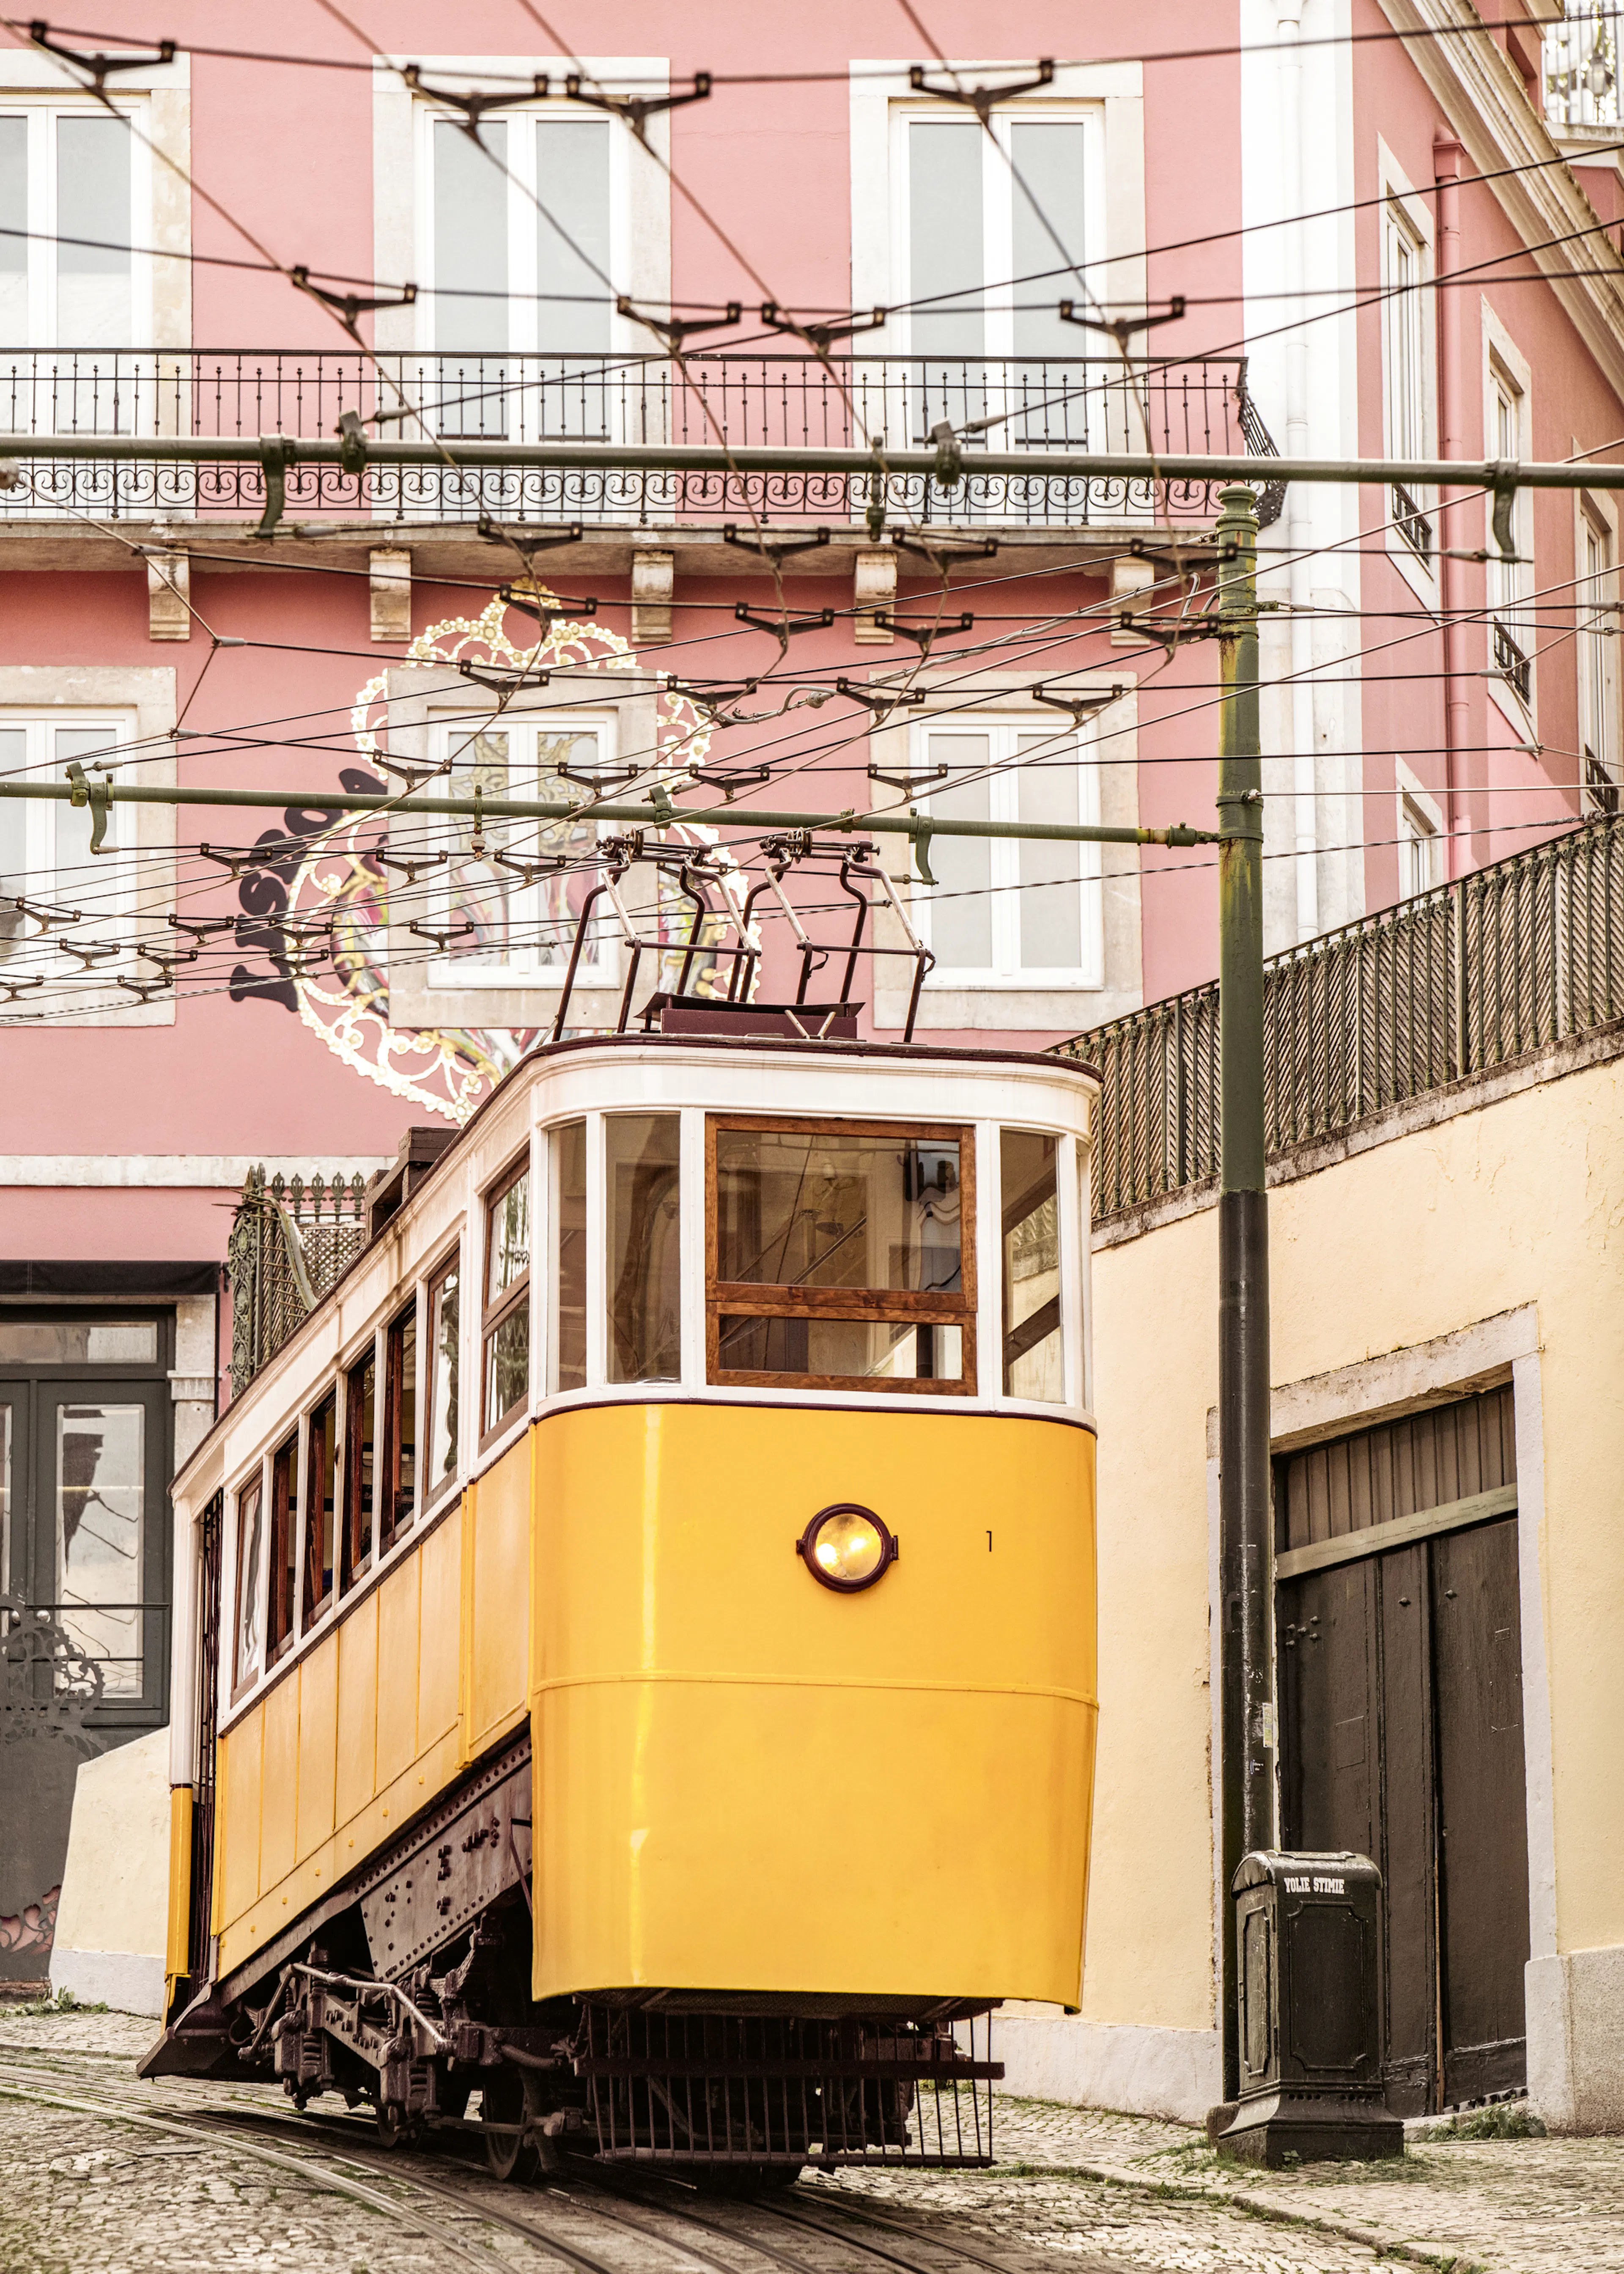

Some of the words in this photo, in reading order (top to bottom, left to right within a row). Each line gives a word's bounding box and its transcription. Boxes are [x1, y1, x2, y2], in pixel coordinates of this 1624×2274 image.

[986, 1530, 992, 1552] 1
[1284, 1877, 1311, 1893] YOLIE
[1313, 1877, 1344, 1894] STIMIE
